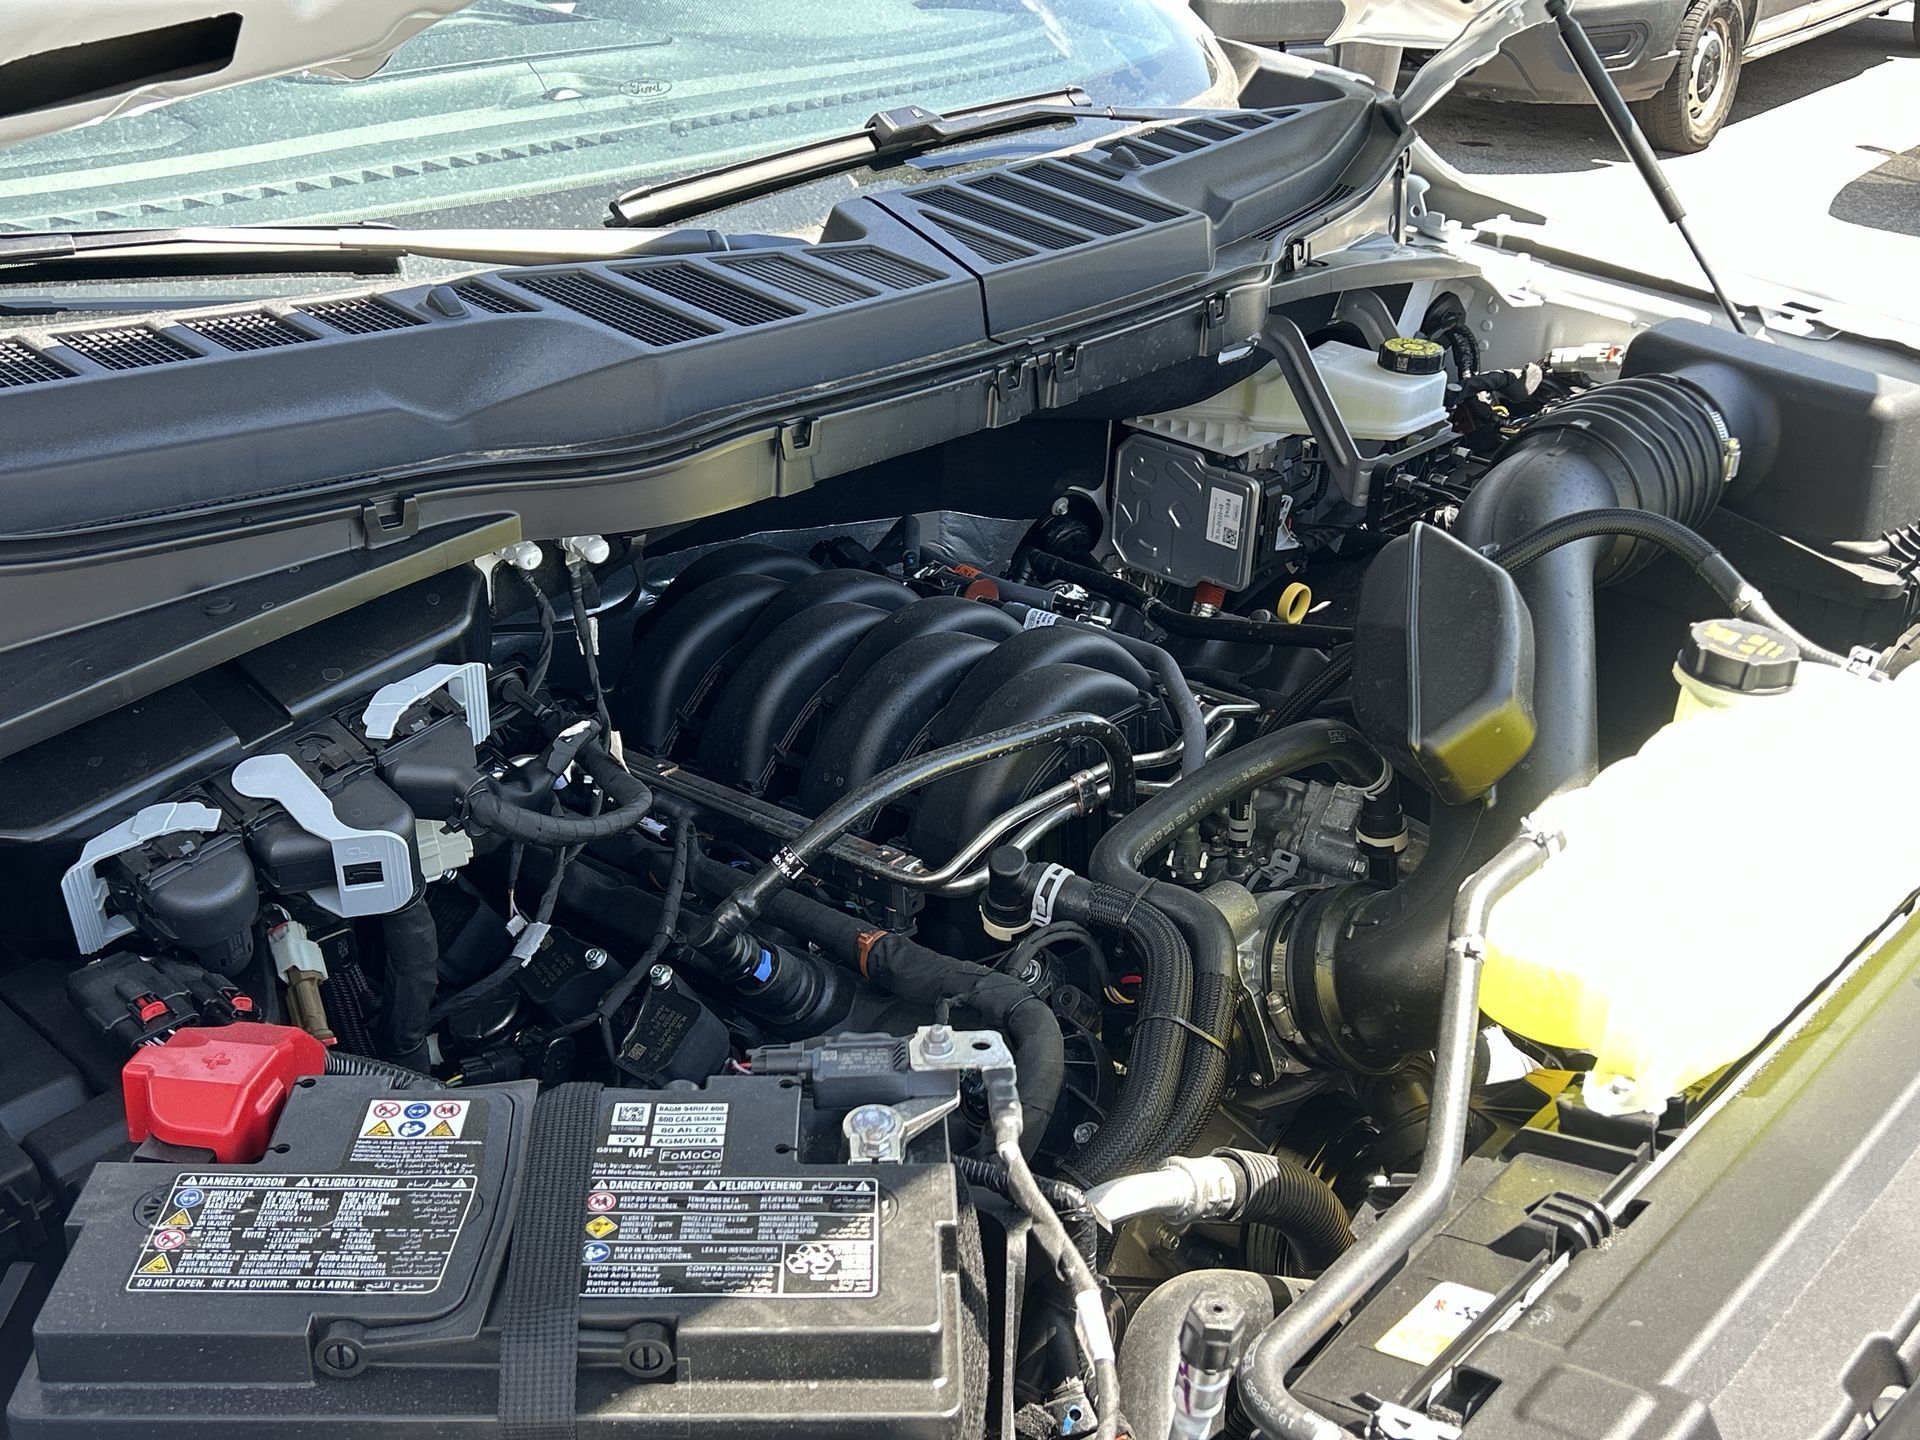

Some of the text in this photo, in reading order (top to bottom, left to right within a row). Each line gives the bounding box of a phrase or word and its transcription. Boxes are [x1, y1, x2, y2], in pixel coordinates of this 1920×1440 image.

[628, 1148, 654, 1158] MF
[661, 1150, 721, 1160] FoMoCo
[199, 1177, 286, 1186] DANGER/POISON
[312, 1178, 398, 1188] PELIGRO/VENENO
[609, 1181, 694, 1190] DANGER/POISON
[719, 1181, 802, 1190] PELIGRO/VENENO
[137, 1279, 152, 1287] DO
[154, 1279, 175, 1287] NOT
[176, 1280, 206, 1288] OPEN.
[249, 1280, 290, 1288] OUVRIR.
